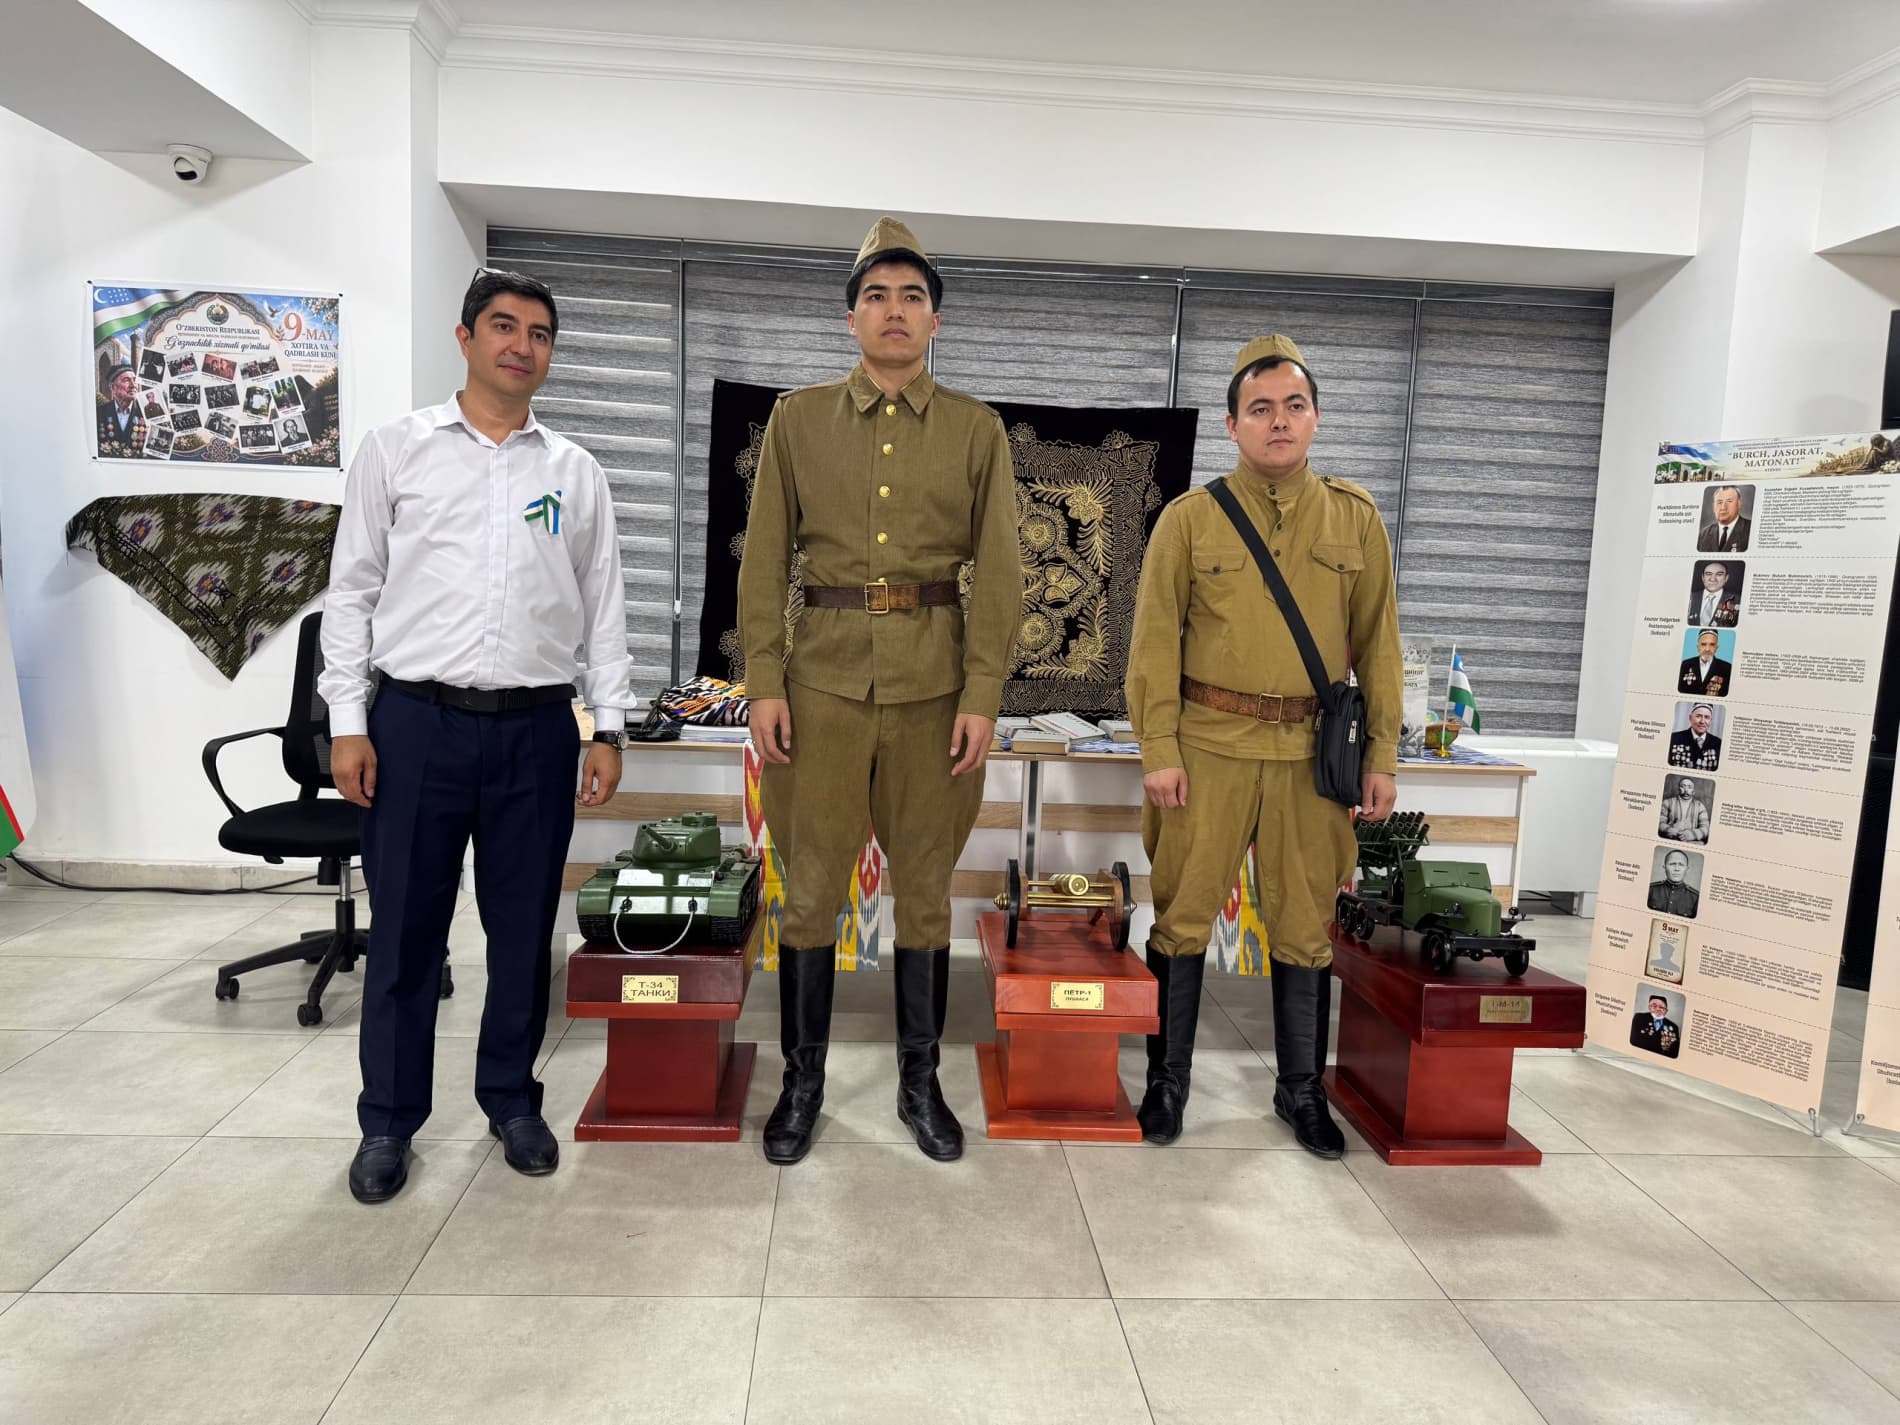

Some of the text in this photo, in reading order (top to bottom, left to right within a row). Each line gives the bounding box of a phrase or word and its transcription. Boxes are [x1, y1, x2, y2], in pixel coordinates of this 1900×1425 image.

[291, 342, 318, 350] XOTIRA
[284, 349, 319, 358] QADRLASH
[638, 981, 663, 989] Т-34
[630, 989, 670, 997] ТАНКИ
